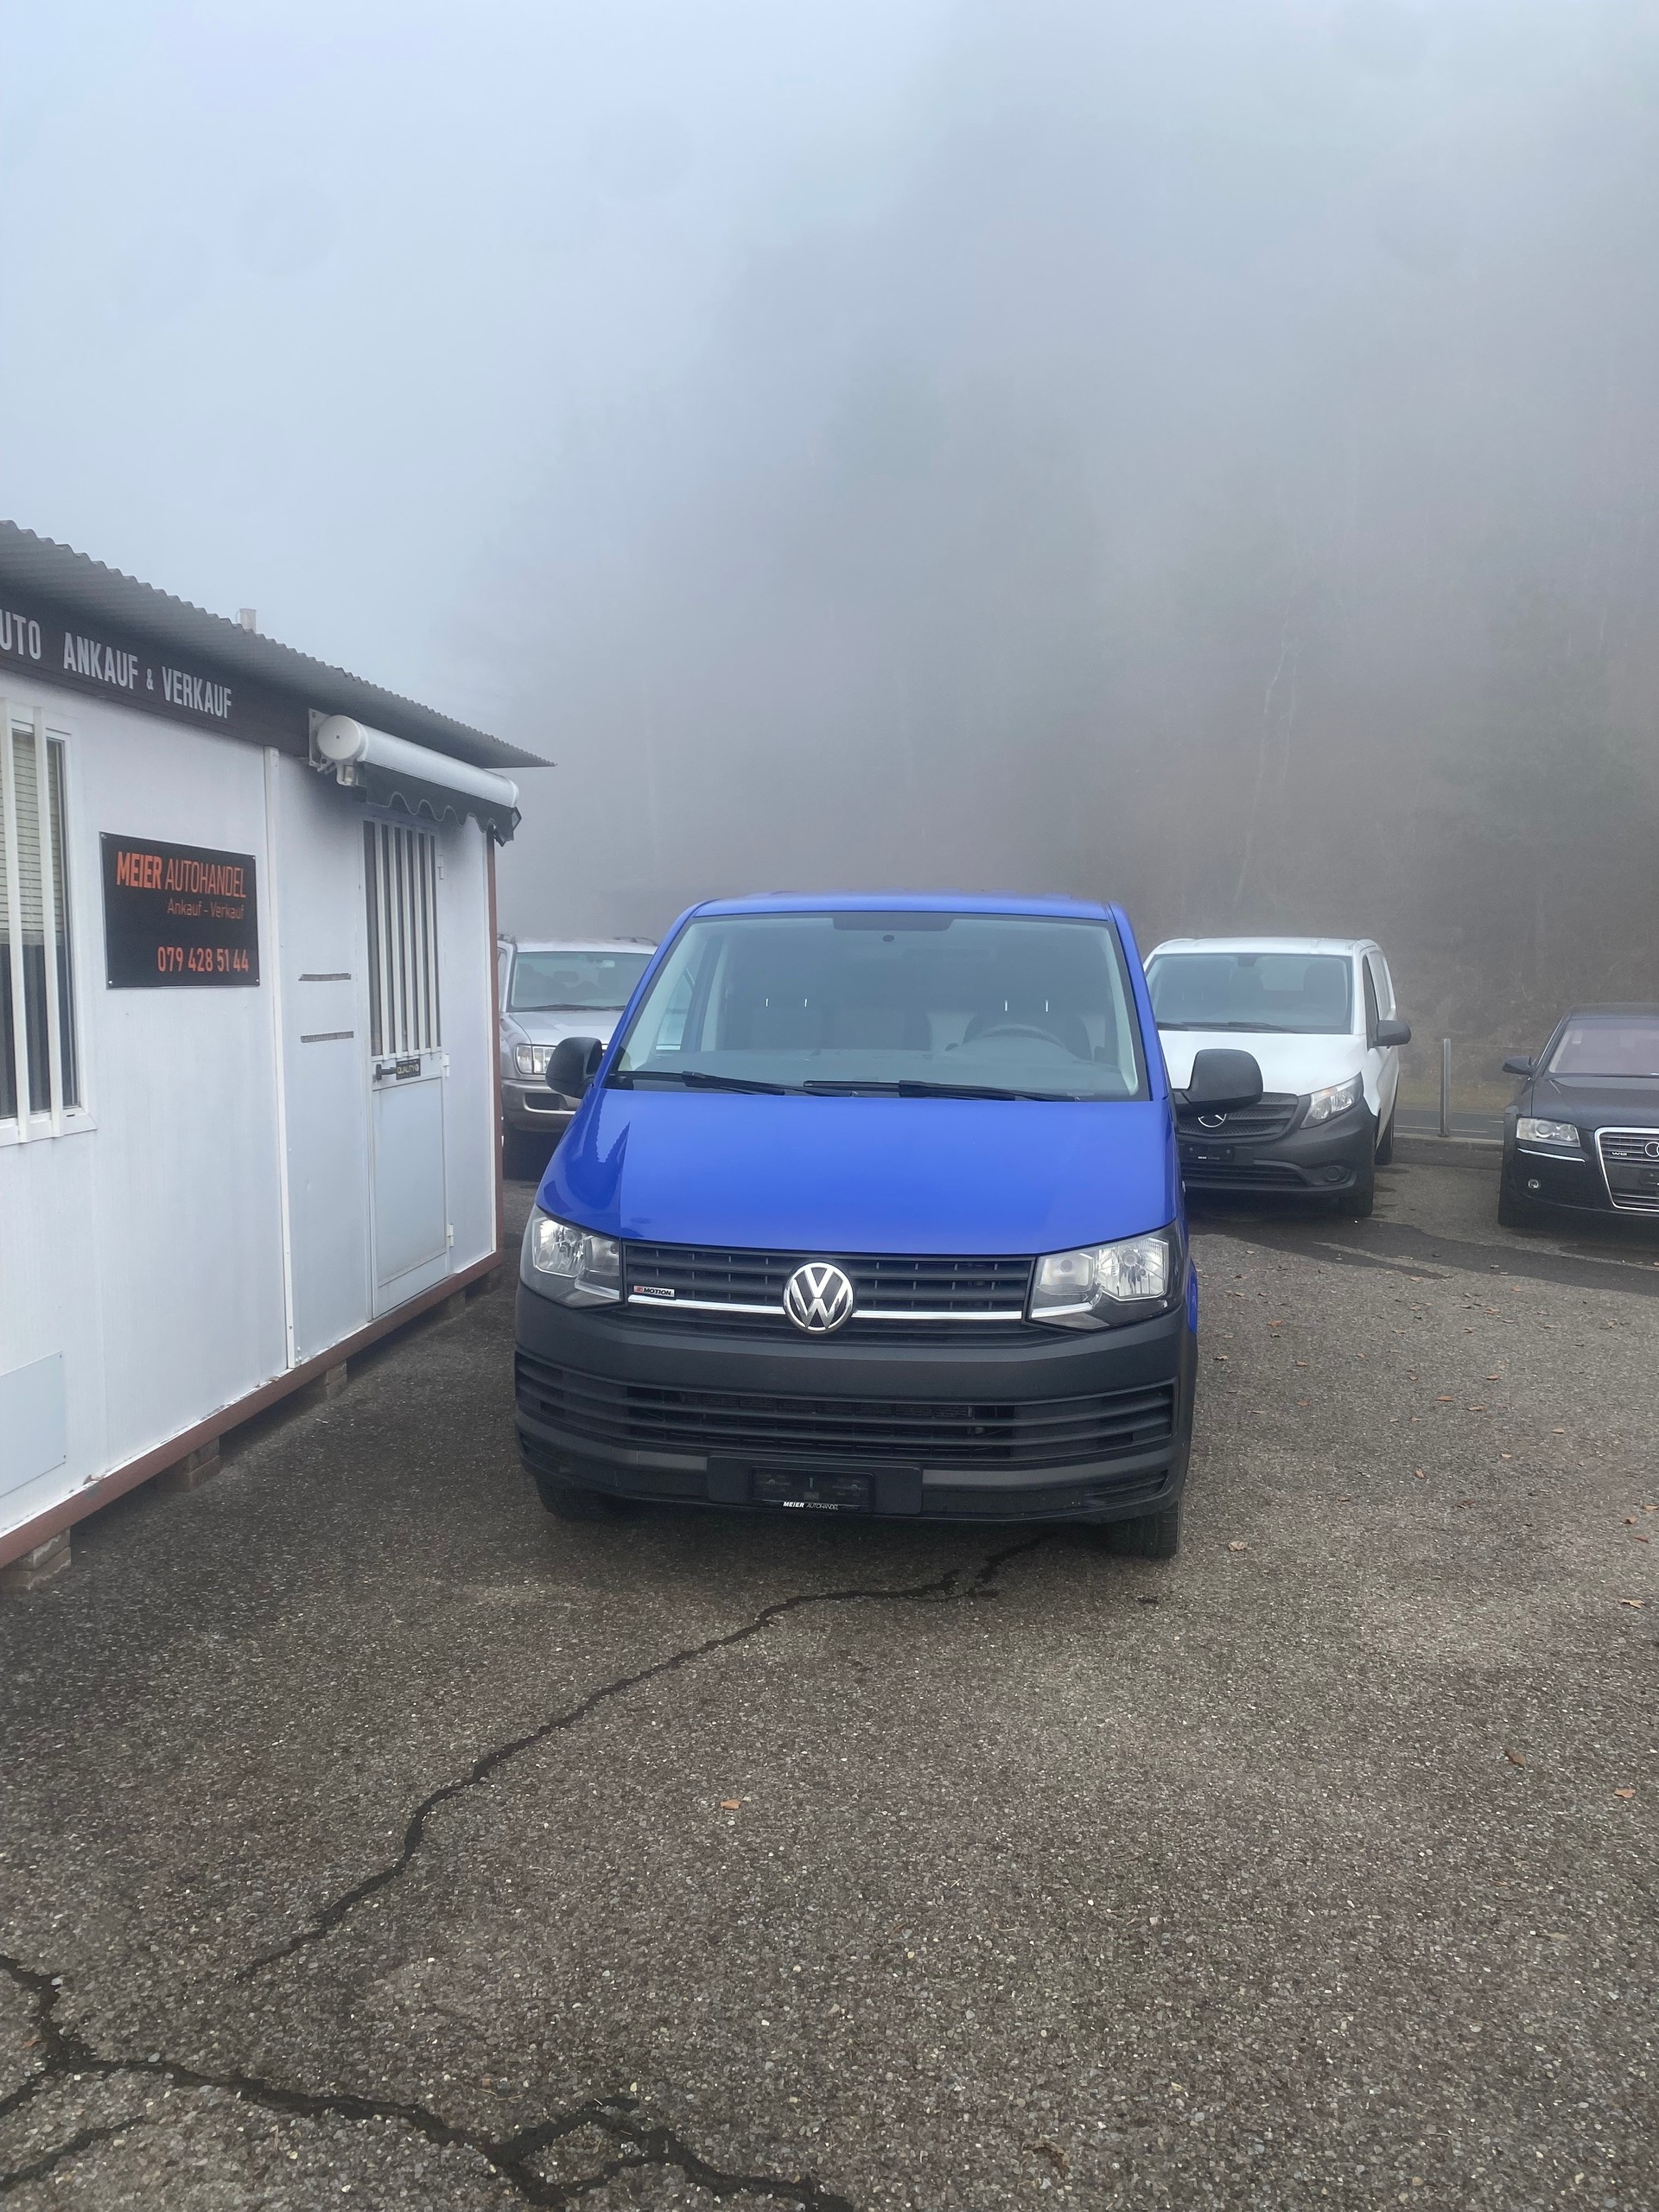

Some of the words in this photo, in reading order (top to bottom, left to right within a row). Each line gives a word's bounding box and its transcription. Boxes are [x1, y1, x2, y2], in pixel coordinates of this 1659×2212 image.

[63, 632, 138, 690] ANKAUF
[146, 667, 154, 690] &
[161, 665, 232, 719] VERKAUF
[117, 851, 162, 889] MEIER
[165, 858, 246, 898] AUTOHANDEL
[168, 899, 202, 917] Ankauf
[210, 902, 245, 919] Verkauf
[157, 946, 183, 972] 079
[188, 948, 213, 972] 428
[217, 948, 229, 972] 51
[232, 949, 249, 972] 44
